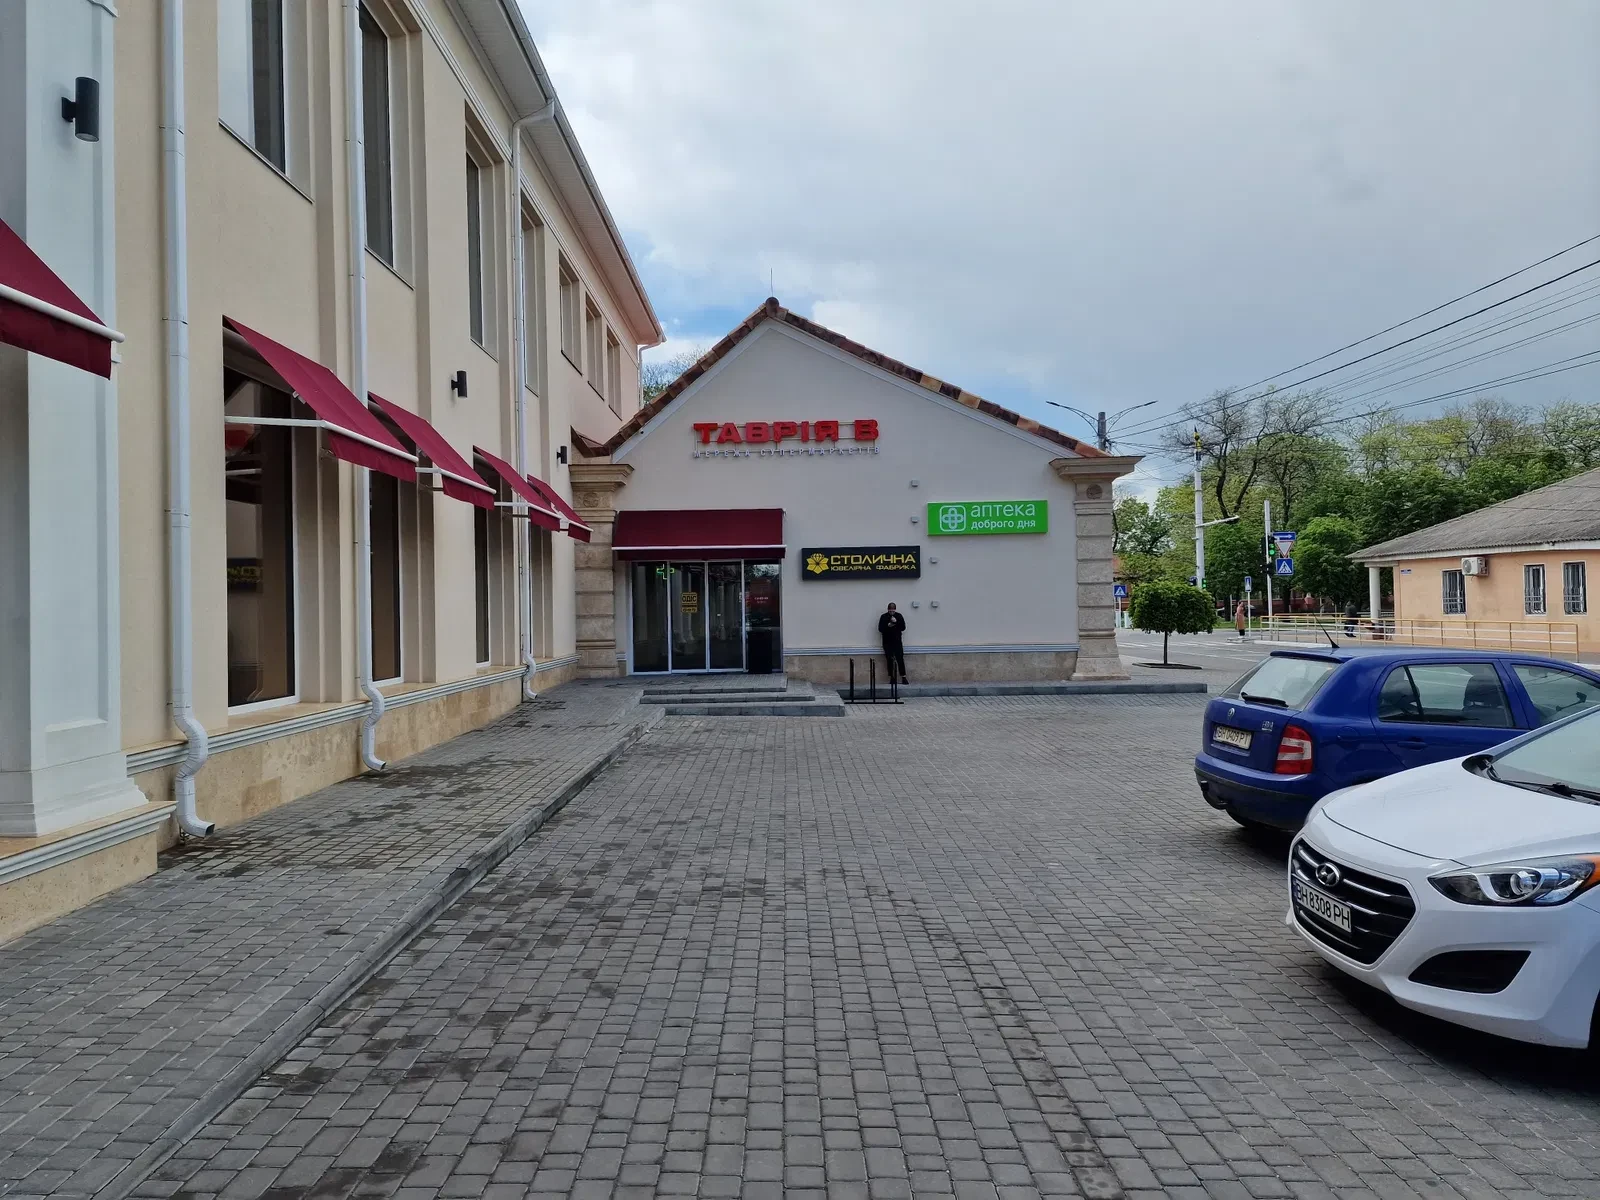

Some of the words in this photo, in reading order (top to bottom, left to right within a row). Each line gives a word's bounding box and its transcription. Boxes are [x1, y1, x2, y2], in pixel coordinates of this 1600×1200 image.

[693, 420, 839, 445] ТАВРІЯ
[854, 419, 879, 441] В
[694, 448, 751, 458] МЕРЕЖА
[970, 503, 1036, 518] аптека
[970, 519, 1015, 530] доброго
[1016, 519, 1036, 529] дня
[830, 553, 916, 565] СТОЛИЧНА
[1309, 891, 1332, 918] 8308
[1333, 904, 1351, 929] PH
